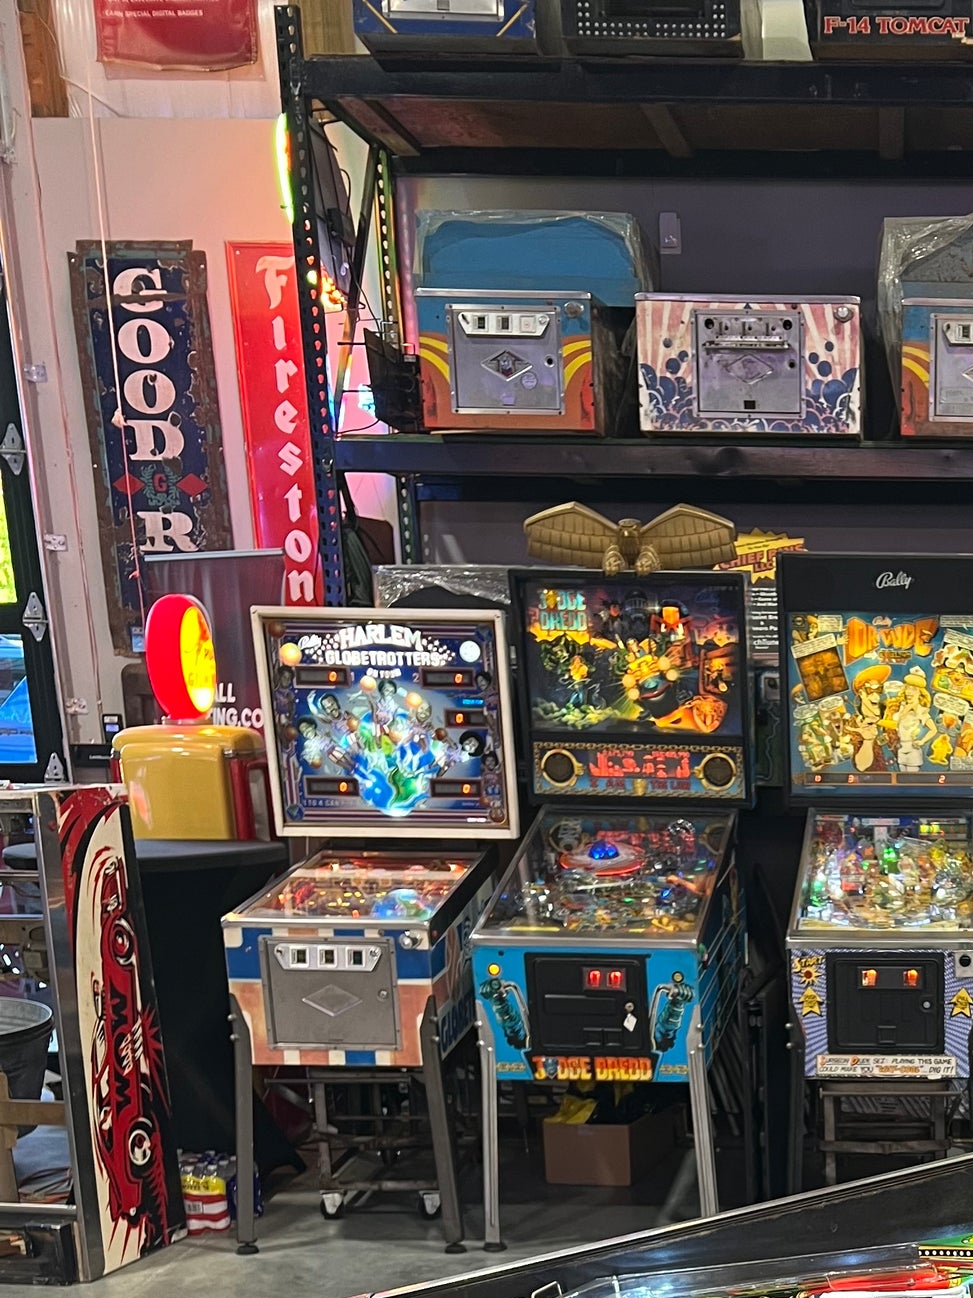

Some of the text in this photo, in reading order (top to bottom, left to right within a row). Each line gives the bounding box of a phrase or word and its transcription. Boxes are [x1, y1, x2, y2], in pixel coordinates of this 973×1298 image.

[125, 10, 151, 18] SPECIAL
[177, 9, 203, 17] BADGES
[823, 16, 970, 35] F-14 TOMCAT
[875, 571, 912, 589] Bally
[339, 623, 425, 651] HARLEM
[325, 650, 441, 667] GLOBETROTTERS
[206, 707, 265, 729] ING.CO
[794, 956, 825, 973] START
[593, 1056, 653, 1081] DREDD
[928, 1066, 941, 1074] DIG
